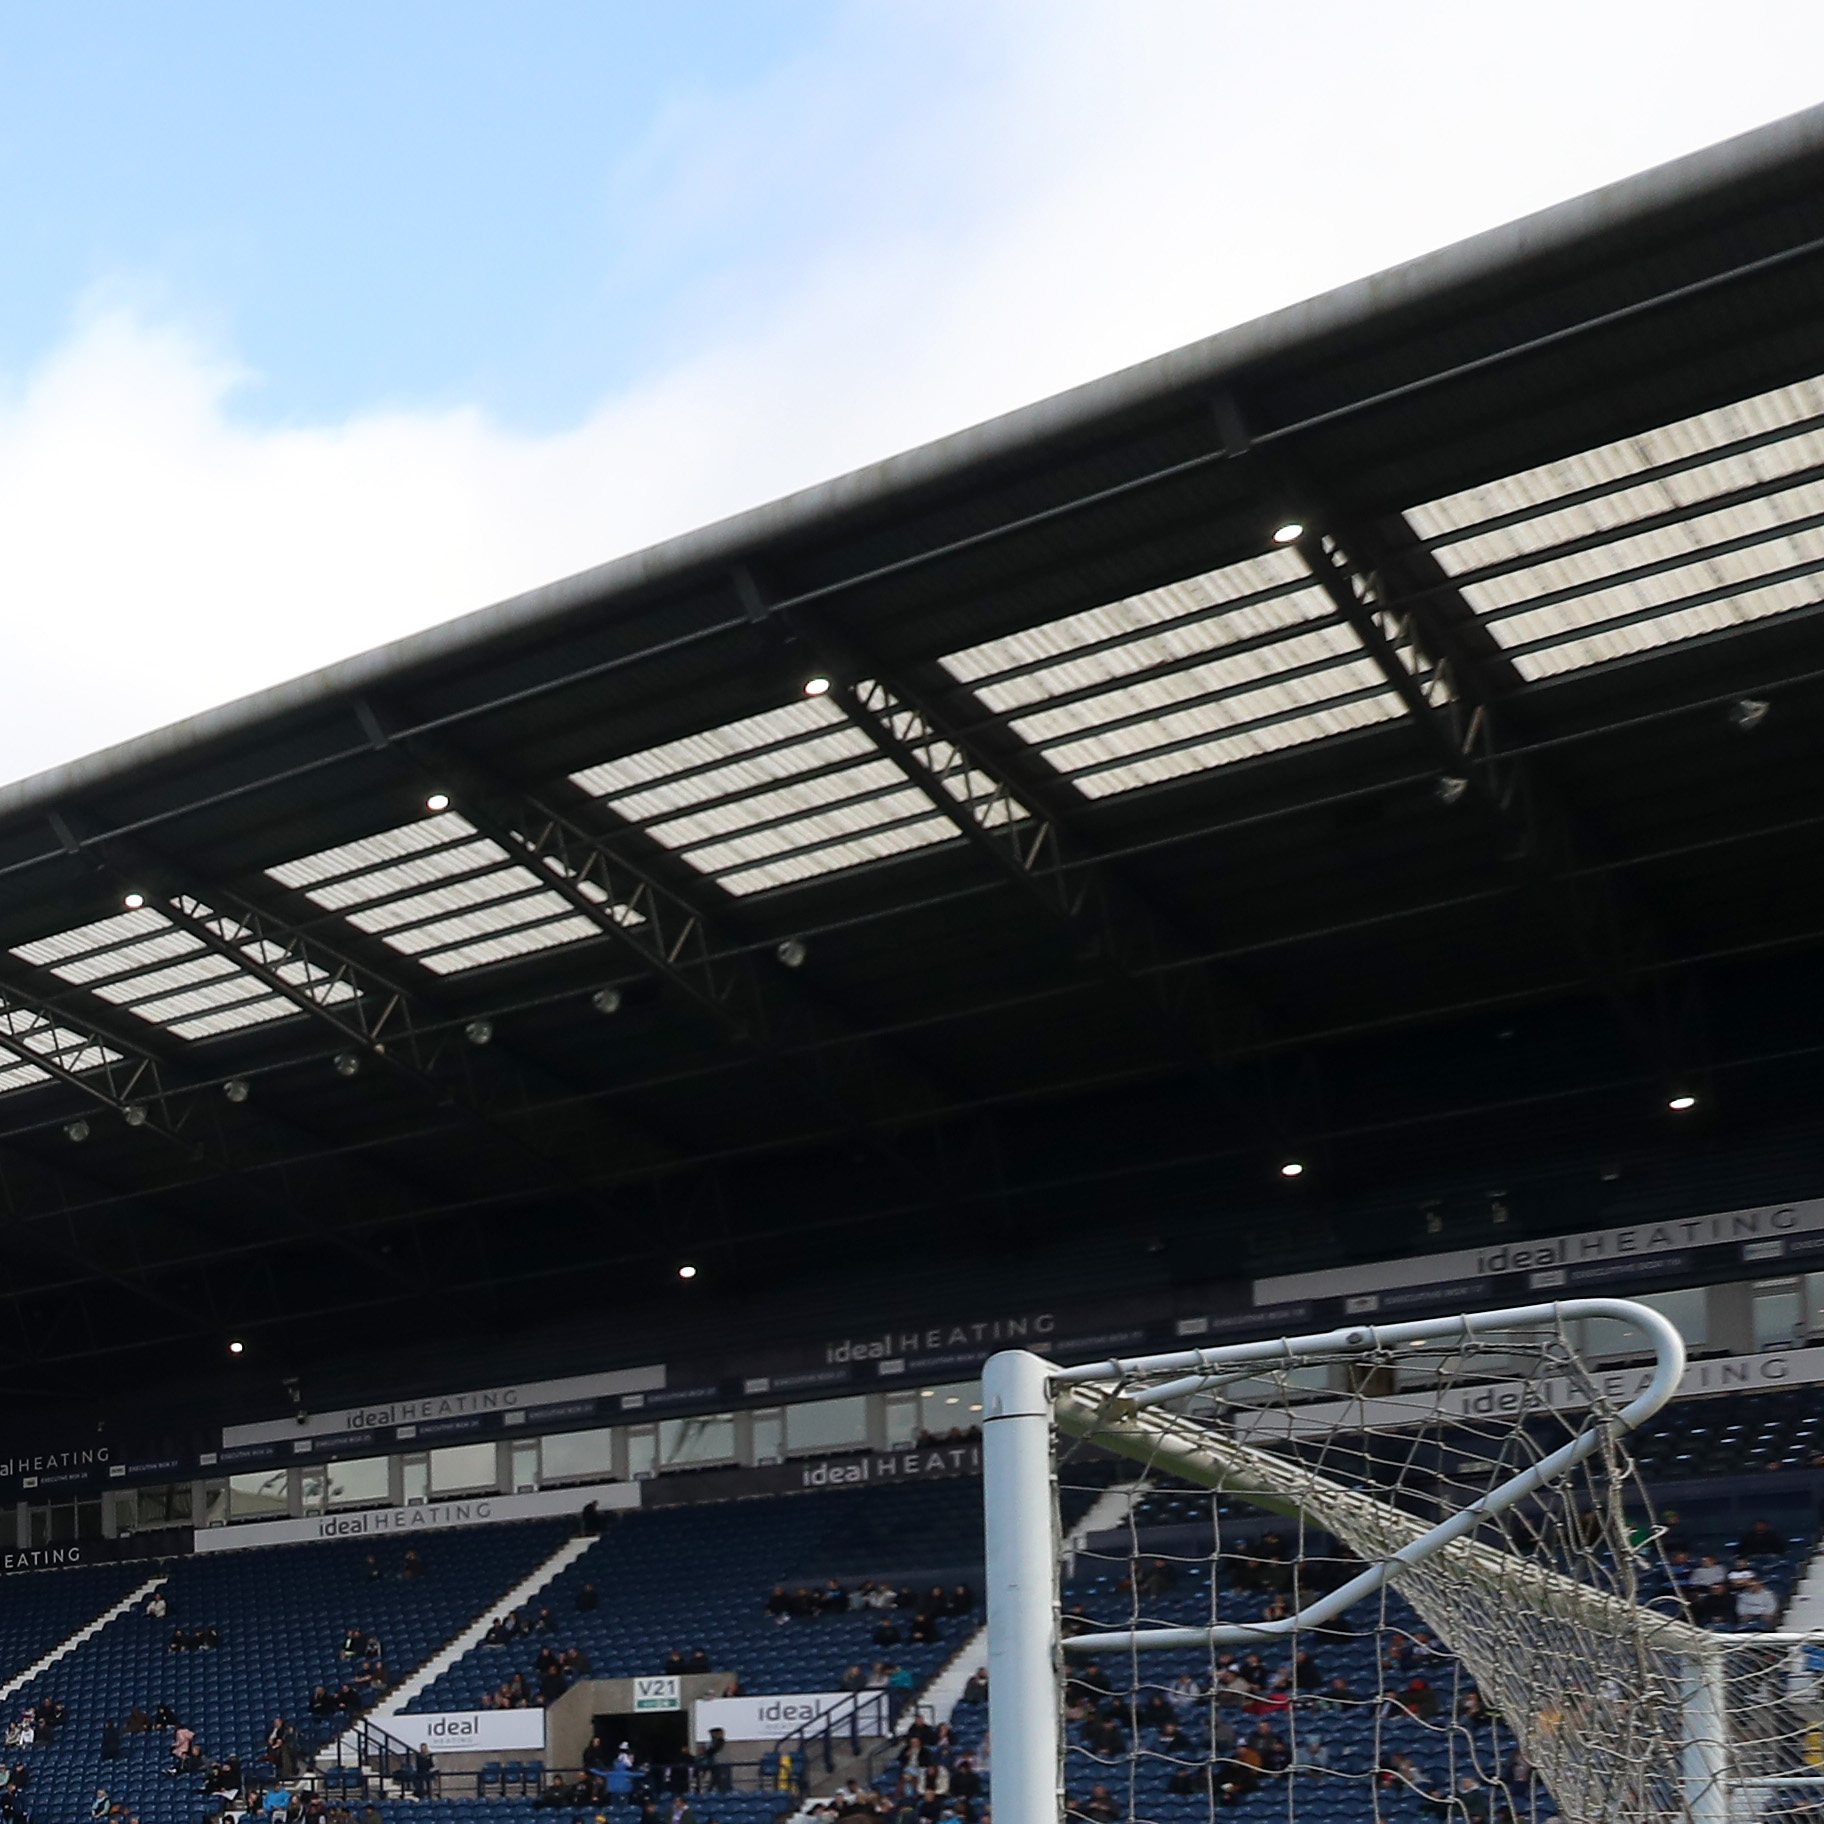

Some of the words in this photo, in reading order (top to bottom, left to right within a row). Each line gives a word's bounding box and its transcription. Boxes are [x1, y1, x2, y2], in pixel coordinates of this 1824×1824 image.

[1476, 1234, 1564, 1274] ideal
[1578, 1208, 1797, 1258] HEATING
[826, 1333, 893, 1365] ideal
[899, 1313, 1056, 1352] HEATING
[1567, 1357, 1791, 1402] HEAING
[346, 1405, 396, 1429] ideal
[402, 1389, 518, 1421] HEATING
[17, 1447, 110, 1473] HEATING
[802, 1458, 870, 1488] ideal
[876, 1447, 980, 1477] HEATI
[320, 1513, 368, 1538] ideal
[375, 1502, 492, 1530] HEATING
[639, 1681, 676, 1697] V21
[428, 1716, 479, 1737] ideal
[759, 1699, 820, 1721] ideal
